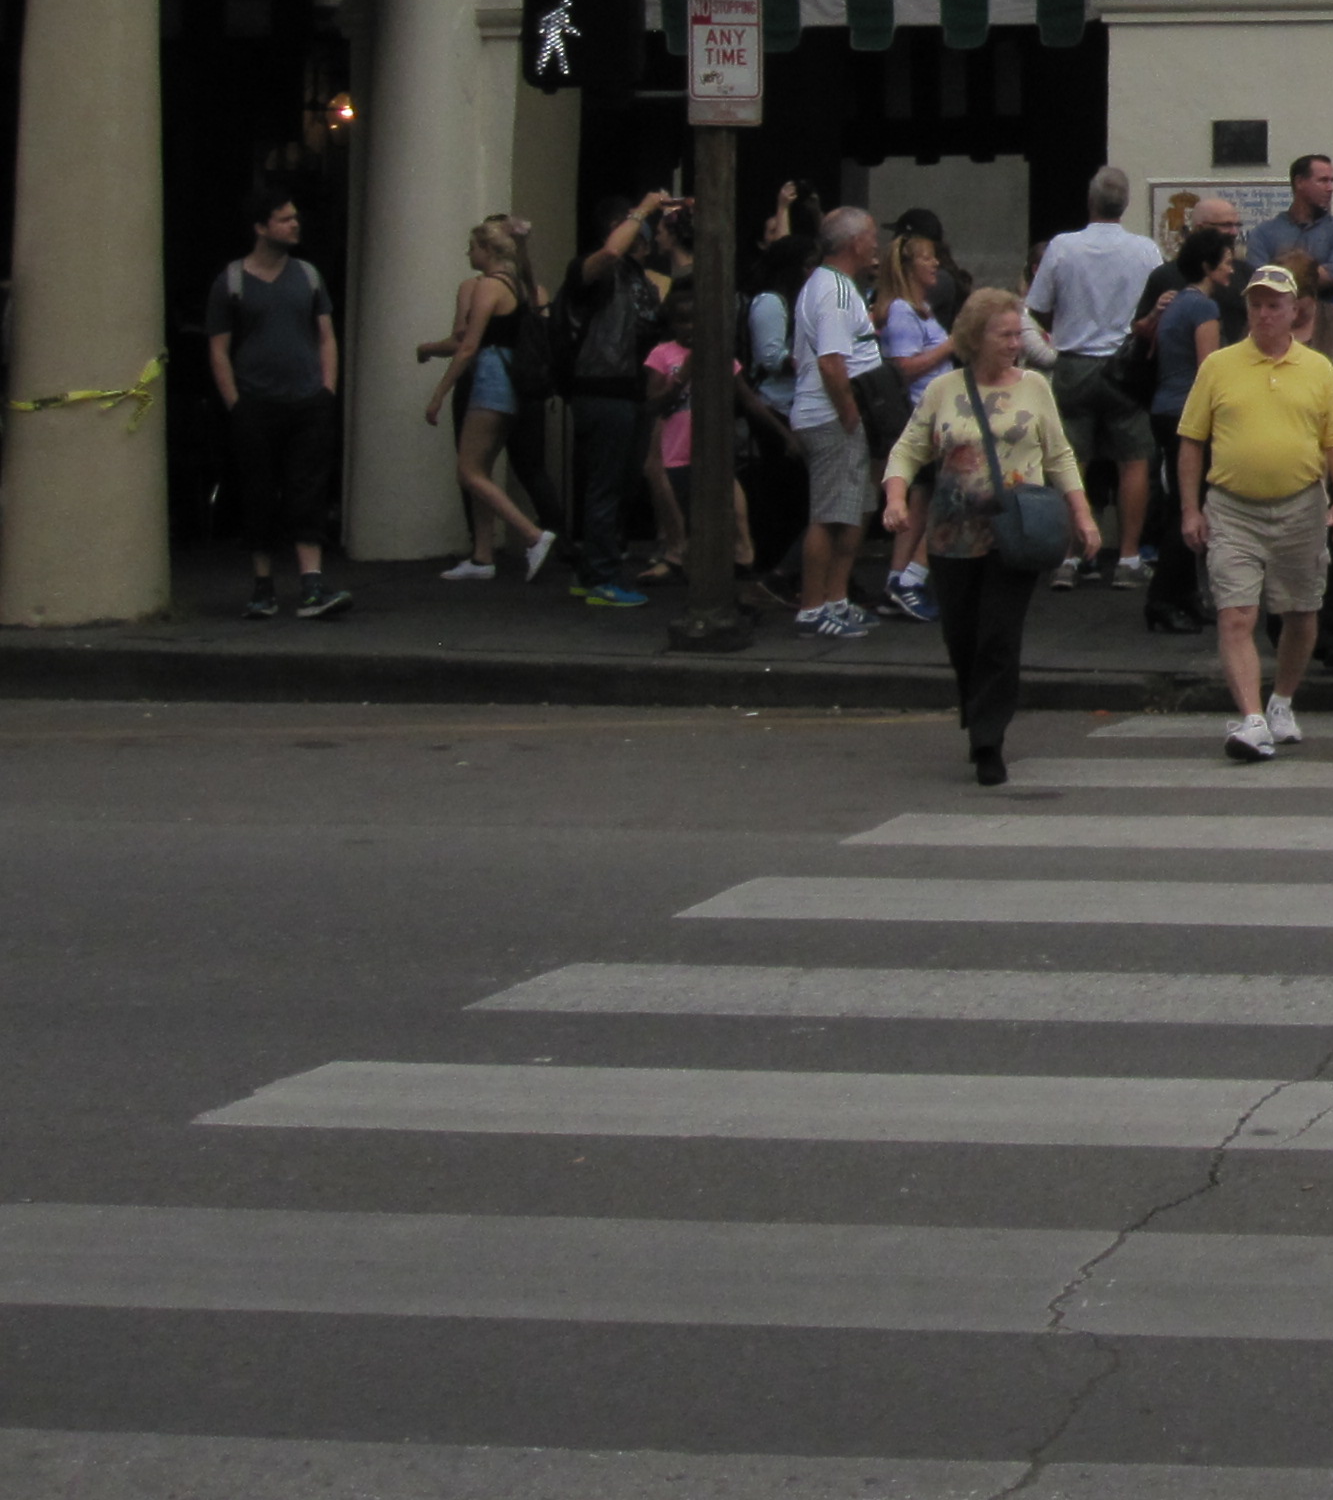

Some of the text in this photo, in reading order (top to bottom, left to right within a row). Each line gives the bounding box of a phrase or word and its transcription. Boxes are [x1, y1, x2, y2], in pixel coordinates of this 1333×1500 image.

[712, 0, 757, 14] STOPPING
[705, 28, 747, 47] ANY
[705, 47, 748, 66] TIME
